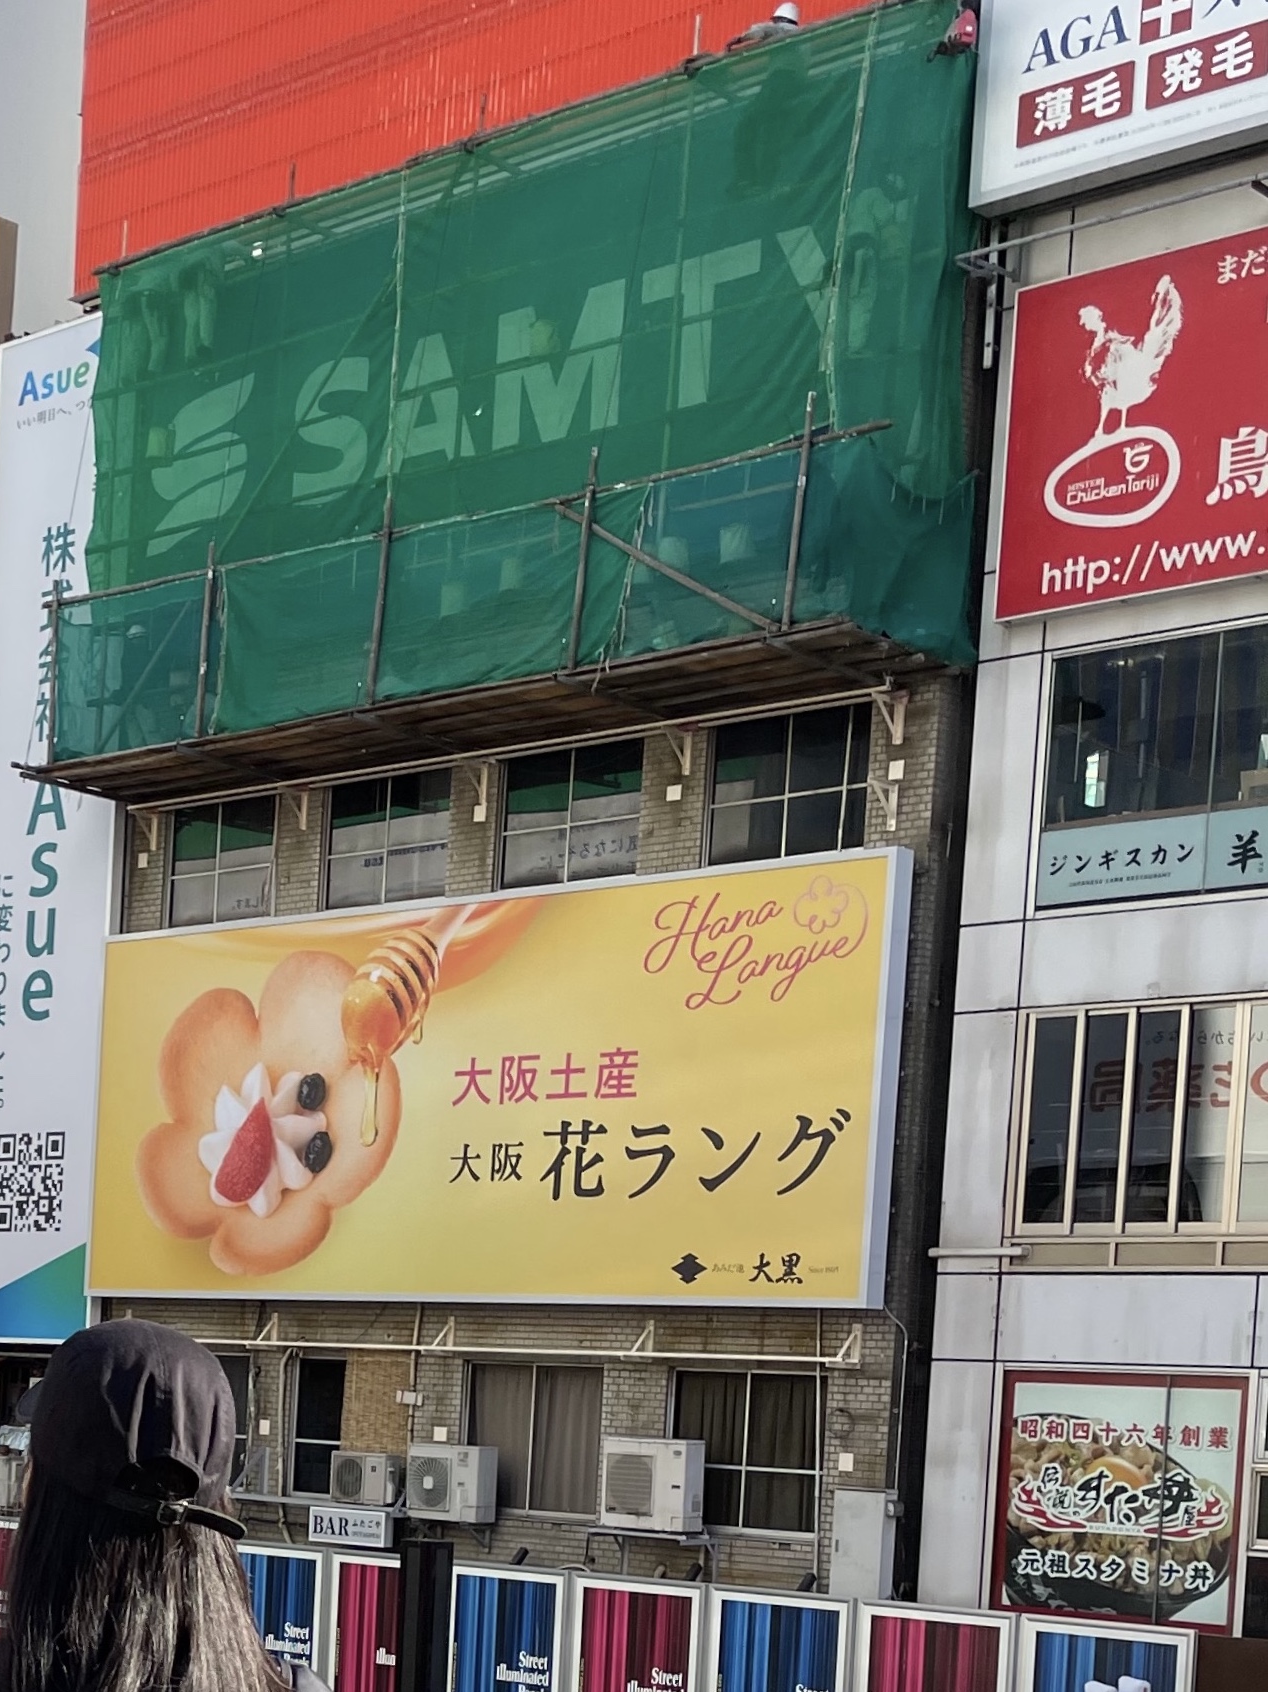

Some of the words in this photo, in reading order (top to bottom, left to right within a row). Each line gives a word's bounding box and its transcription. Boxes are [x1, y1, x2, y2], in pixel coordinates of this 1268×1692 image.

[1022, 5, 1131, 74] AGA
[1162, 31, 1254, 98] 発毛
[1034, 71, 1123, 136] 薄毛
[18, 361, 90, 406] Asue
[1041, 530, 1266, 596] http://www.
[1049, 843, 1195, 877] ジンギスカン
[1226, 829, 1264, 874] 羊
[644, 892, 784, 974] Hana
[685, 934, 850, 1011] Langue
[451, 1047, 639, 1107] 大阪土産
[449, 1141, 525, 1184] 大阪
[540, 1108, 852, 1201] 花ラング
[748, 1252, 803, 1285] 大黒
[1019, 1418, 1230, 1450] 昭和四十六年創業
[312, 1514, 350, 1537] BAR
[1019, 1550, 1211, 1588] 元祖スタミナ丼
[284, 1621, 309, 1640] Street
[518, 1651, 548, 1670] Street
[651, 1667, 683, 1688] Street
